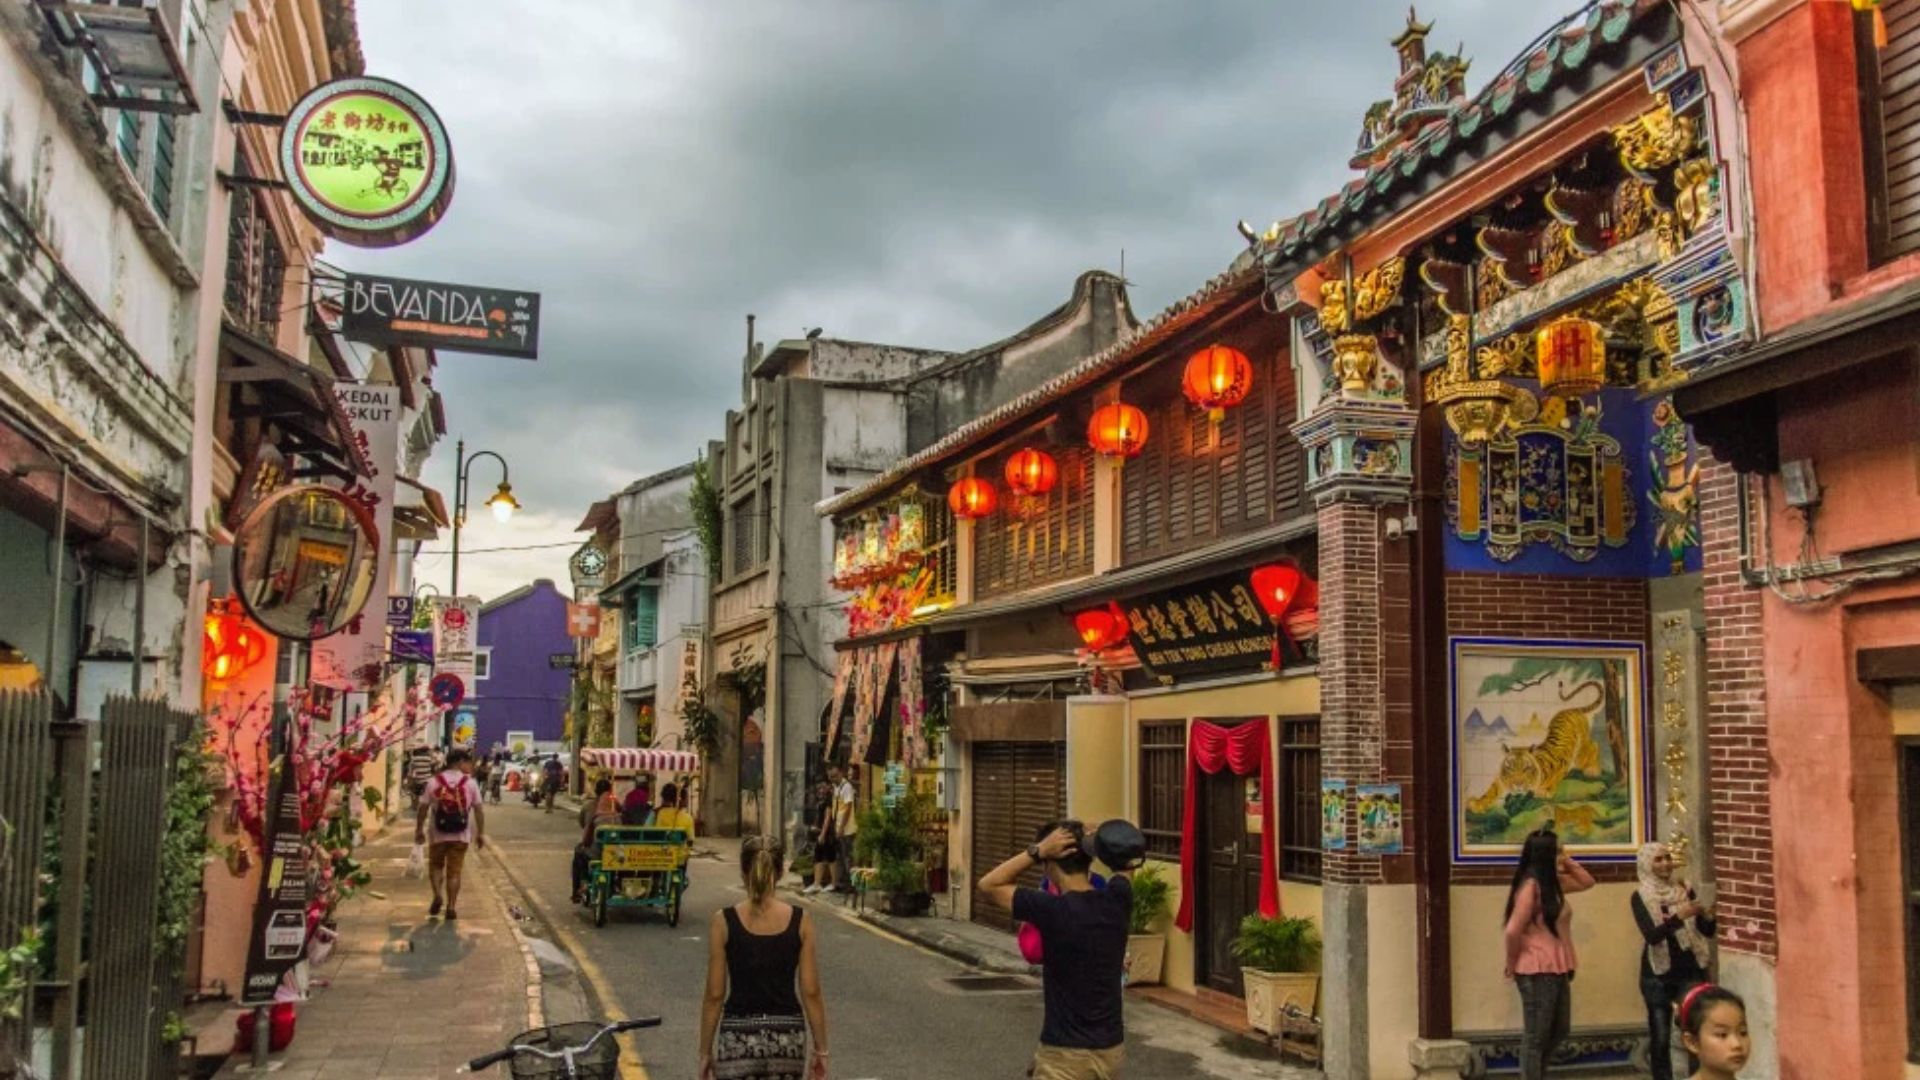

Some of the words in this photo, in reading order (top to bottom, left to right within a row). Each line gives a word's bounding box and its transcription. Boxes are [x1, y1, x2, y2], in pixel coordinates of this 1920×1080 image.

[352, 280, 488, 326] BEVANDA
[339, 389, 388, 405] KEDAI
[350, 405, 392, 421] SKUT
[1206, 641, 1238, 658] CHEAH
[1236, 635, 1272, 654] KONGS
